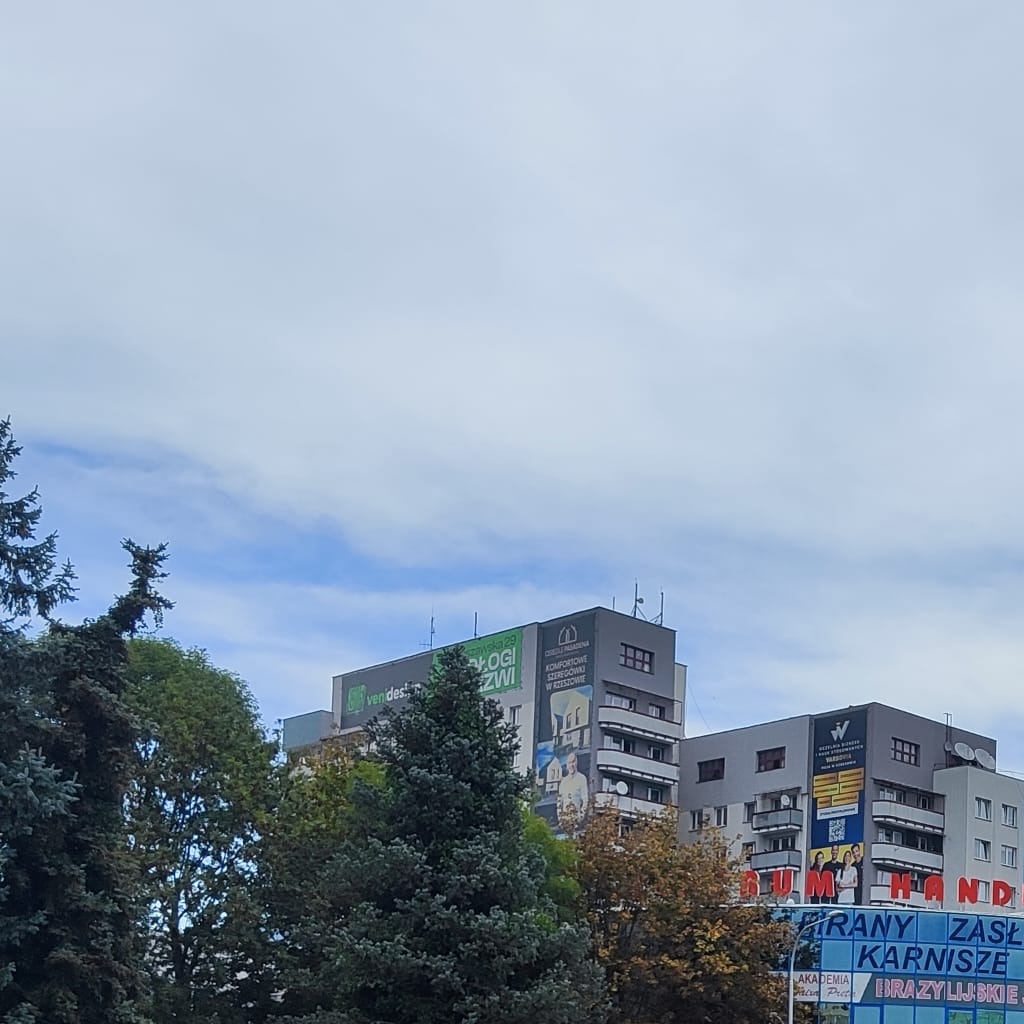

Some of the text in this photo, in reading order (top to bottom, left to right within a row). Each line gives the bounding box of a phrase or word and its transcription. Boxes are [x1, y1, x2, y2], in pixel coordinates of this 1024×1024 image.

[504, 634, 516, 647] 29
[546, 654, 588, 673] KOMFORTOWE
[545, 675, 586, 692] W RZESZOWIE
[857, 944, 1010, 976] KARNISZE
[798, 974, 850, 985] AKADEMIA
[875, 977, 1019, 1006] BRAZYLIJSKIE
